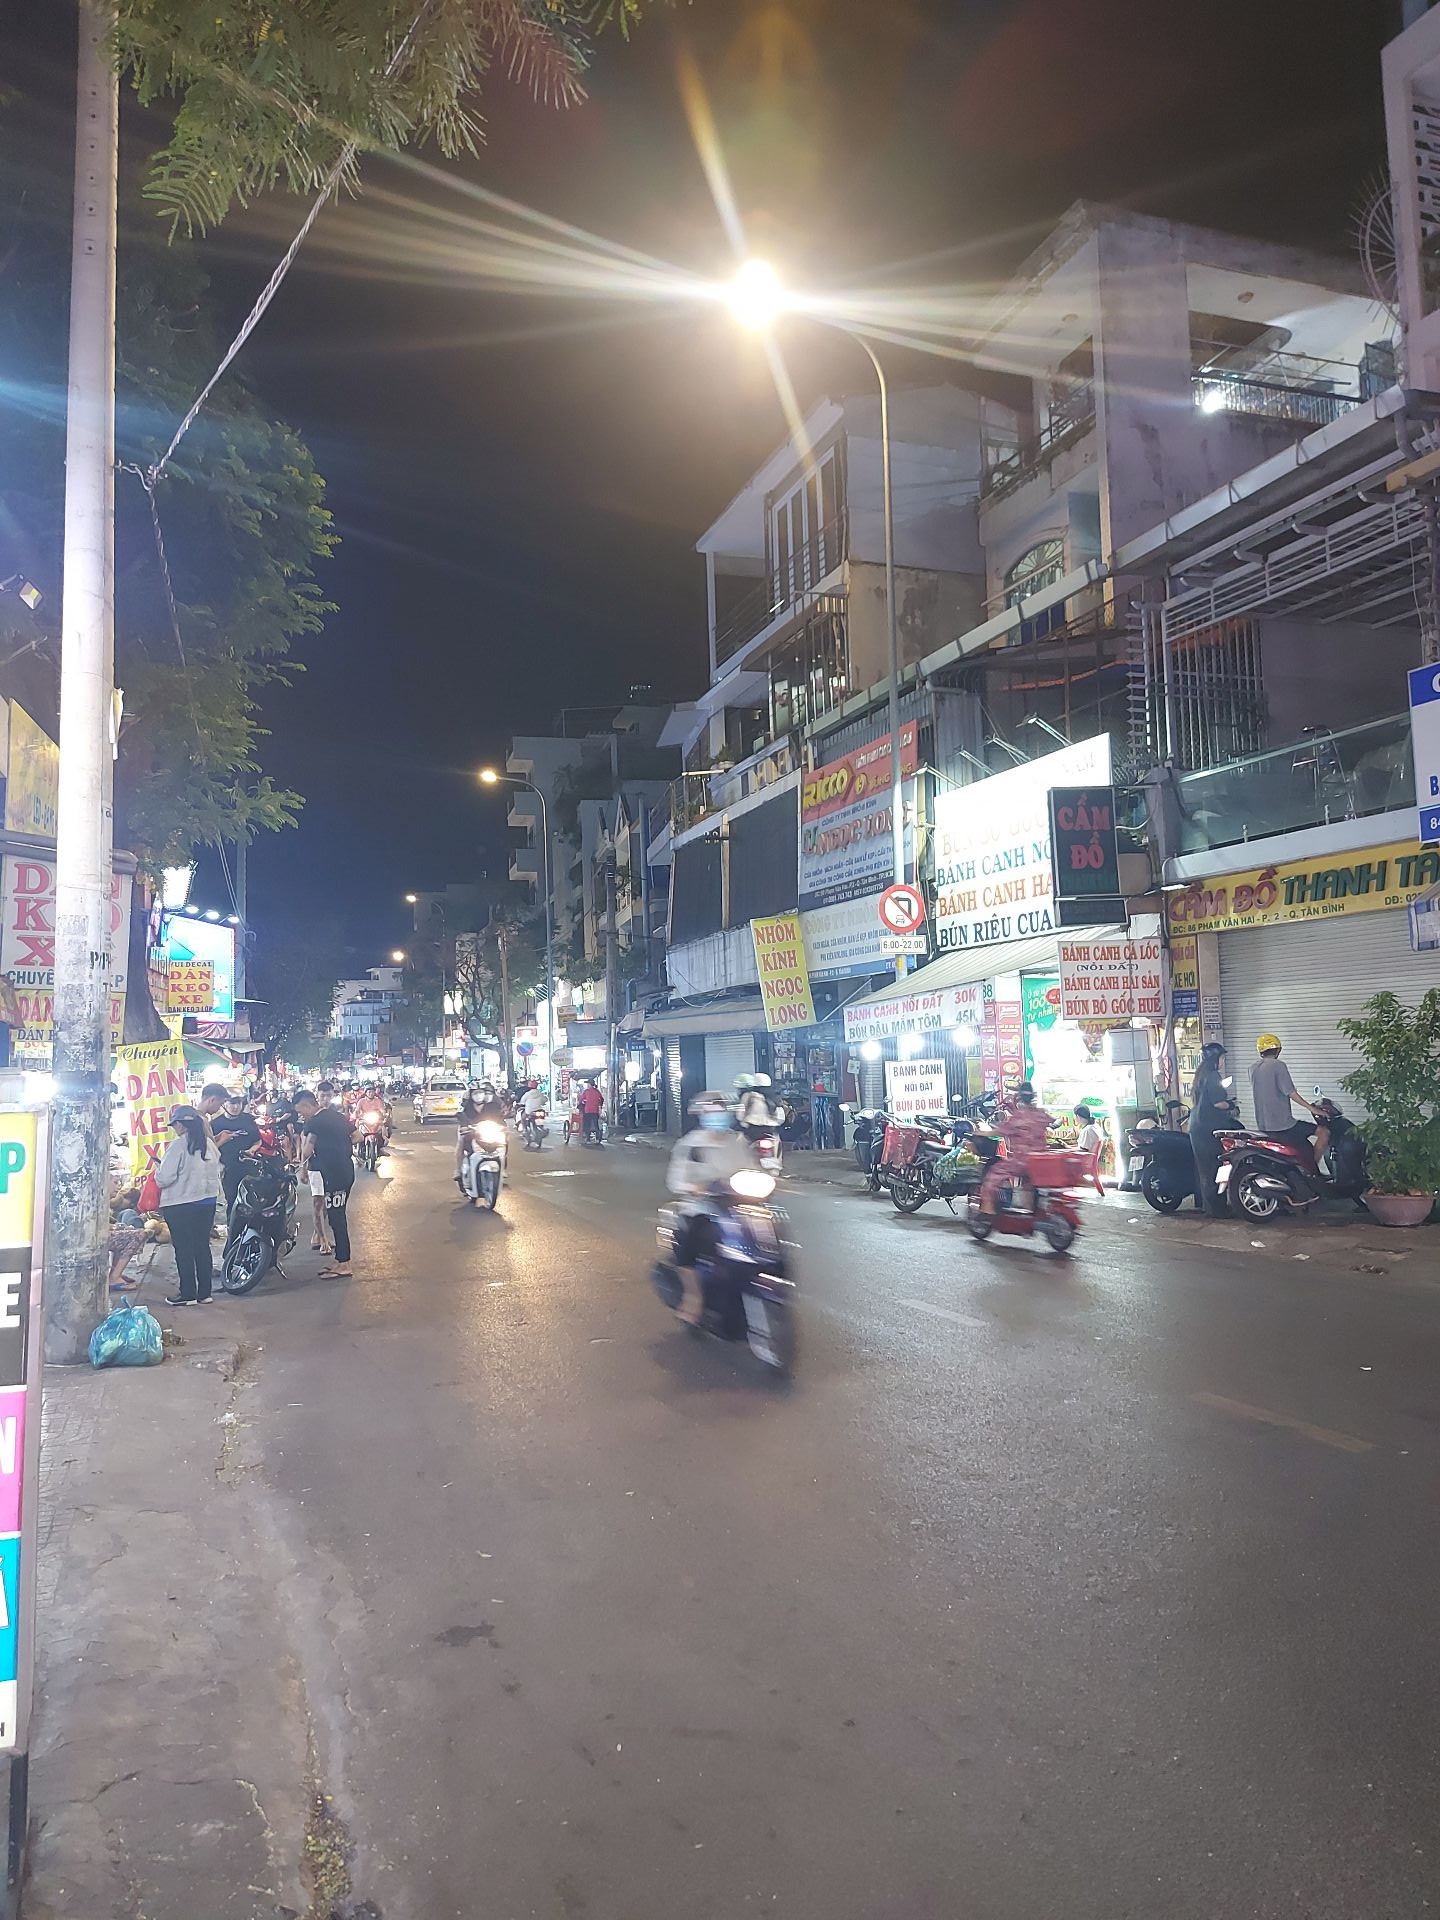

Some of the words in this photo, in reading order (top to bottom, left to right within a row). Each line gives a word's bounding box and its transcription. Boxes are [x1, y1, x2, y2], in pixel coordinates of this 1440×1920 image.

[1057, 792, 1111, 830] CẦM
[1070, 832, 1104, 869] ĐỒ
[937, 859, 976, 887] BÁNH
[982, 845, 1025, 875] CANH
[939, 887, 977, 917] BÁNH
[983, 878, 1026, 908] CANH
[1169, 881, 1227, 922] CẦM
[1232, 867, 1277, 914] ĐỒ
[1280, 860, 1388, 906] THANH
[940, 921, 968, 949] BÚN
[973, 914, 1011, 942] RIÊU
[1018, 909, 1053, 935] CUA
[1198, 921, 1220, 931] PHẠM
[1241, 915, 1255, 925] HAI
[1302, 906, 1320, 917] TÂN
[1322, 903, 1345, 915] BÌNH
[754, 919, 797, 945] NHÔM
[761, 947, 798, 972] KÍNH
[1062, 942, 1090, 961] BÁNH
[1093, 946, 1120, 961] CANH
[1123, 942, 1137, 960] CÁ
[1140, 941, 1159, 959] LÓC
[7, 968, 55, 985] CHUYÊ
[171, 983, 210, 992] KEO
[764, 976, 803, 1000] NGỌC
[1064, 973, 1090, 991] BÁNH
[1094, 976, 1120, 990] CANH
[1141, 969, 1160, 989] SẢN
[178, 995, 203, 1004] XE
[873, 1003, 899, 1018] CANH
[954, 988, 977, 1005] 30K
[1065, 995, 1089, 1016] BÚN
[1093, 994, 1107, 1015] BÒ
[1111, 991, 1135, 1015] GỐC
[1138, 990, 1161, 1013] HUẾ
[769, 1002, 808, 1026] LONG
[918, 1013, 942, 1028] TÔM
[17, 1026, 44, 1041] DÁN
[122, 1044, 178, 1062] Chuyên
[127, 1064, 186, 1100] DÁN
[919, 1063, 943, 1076] CANH
